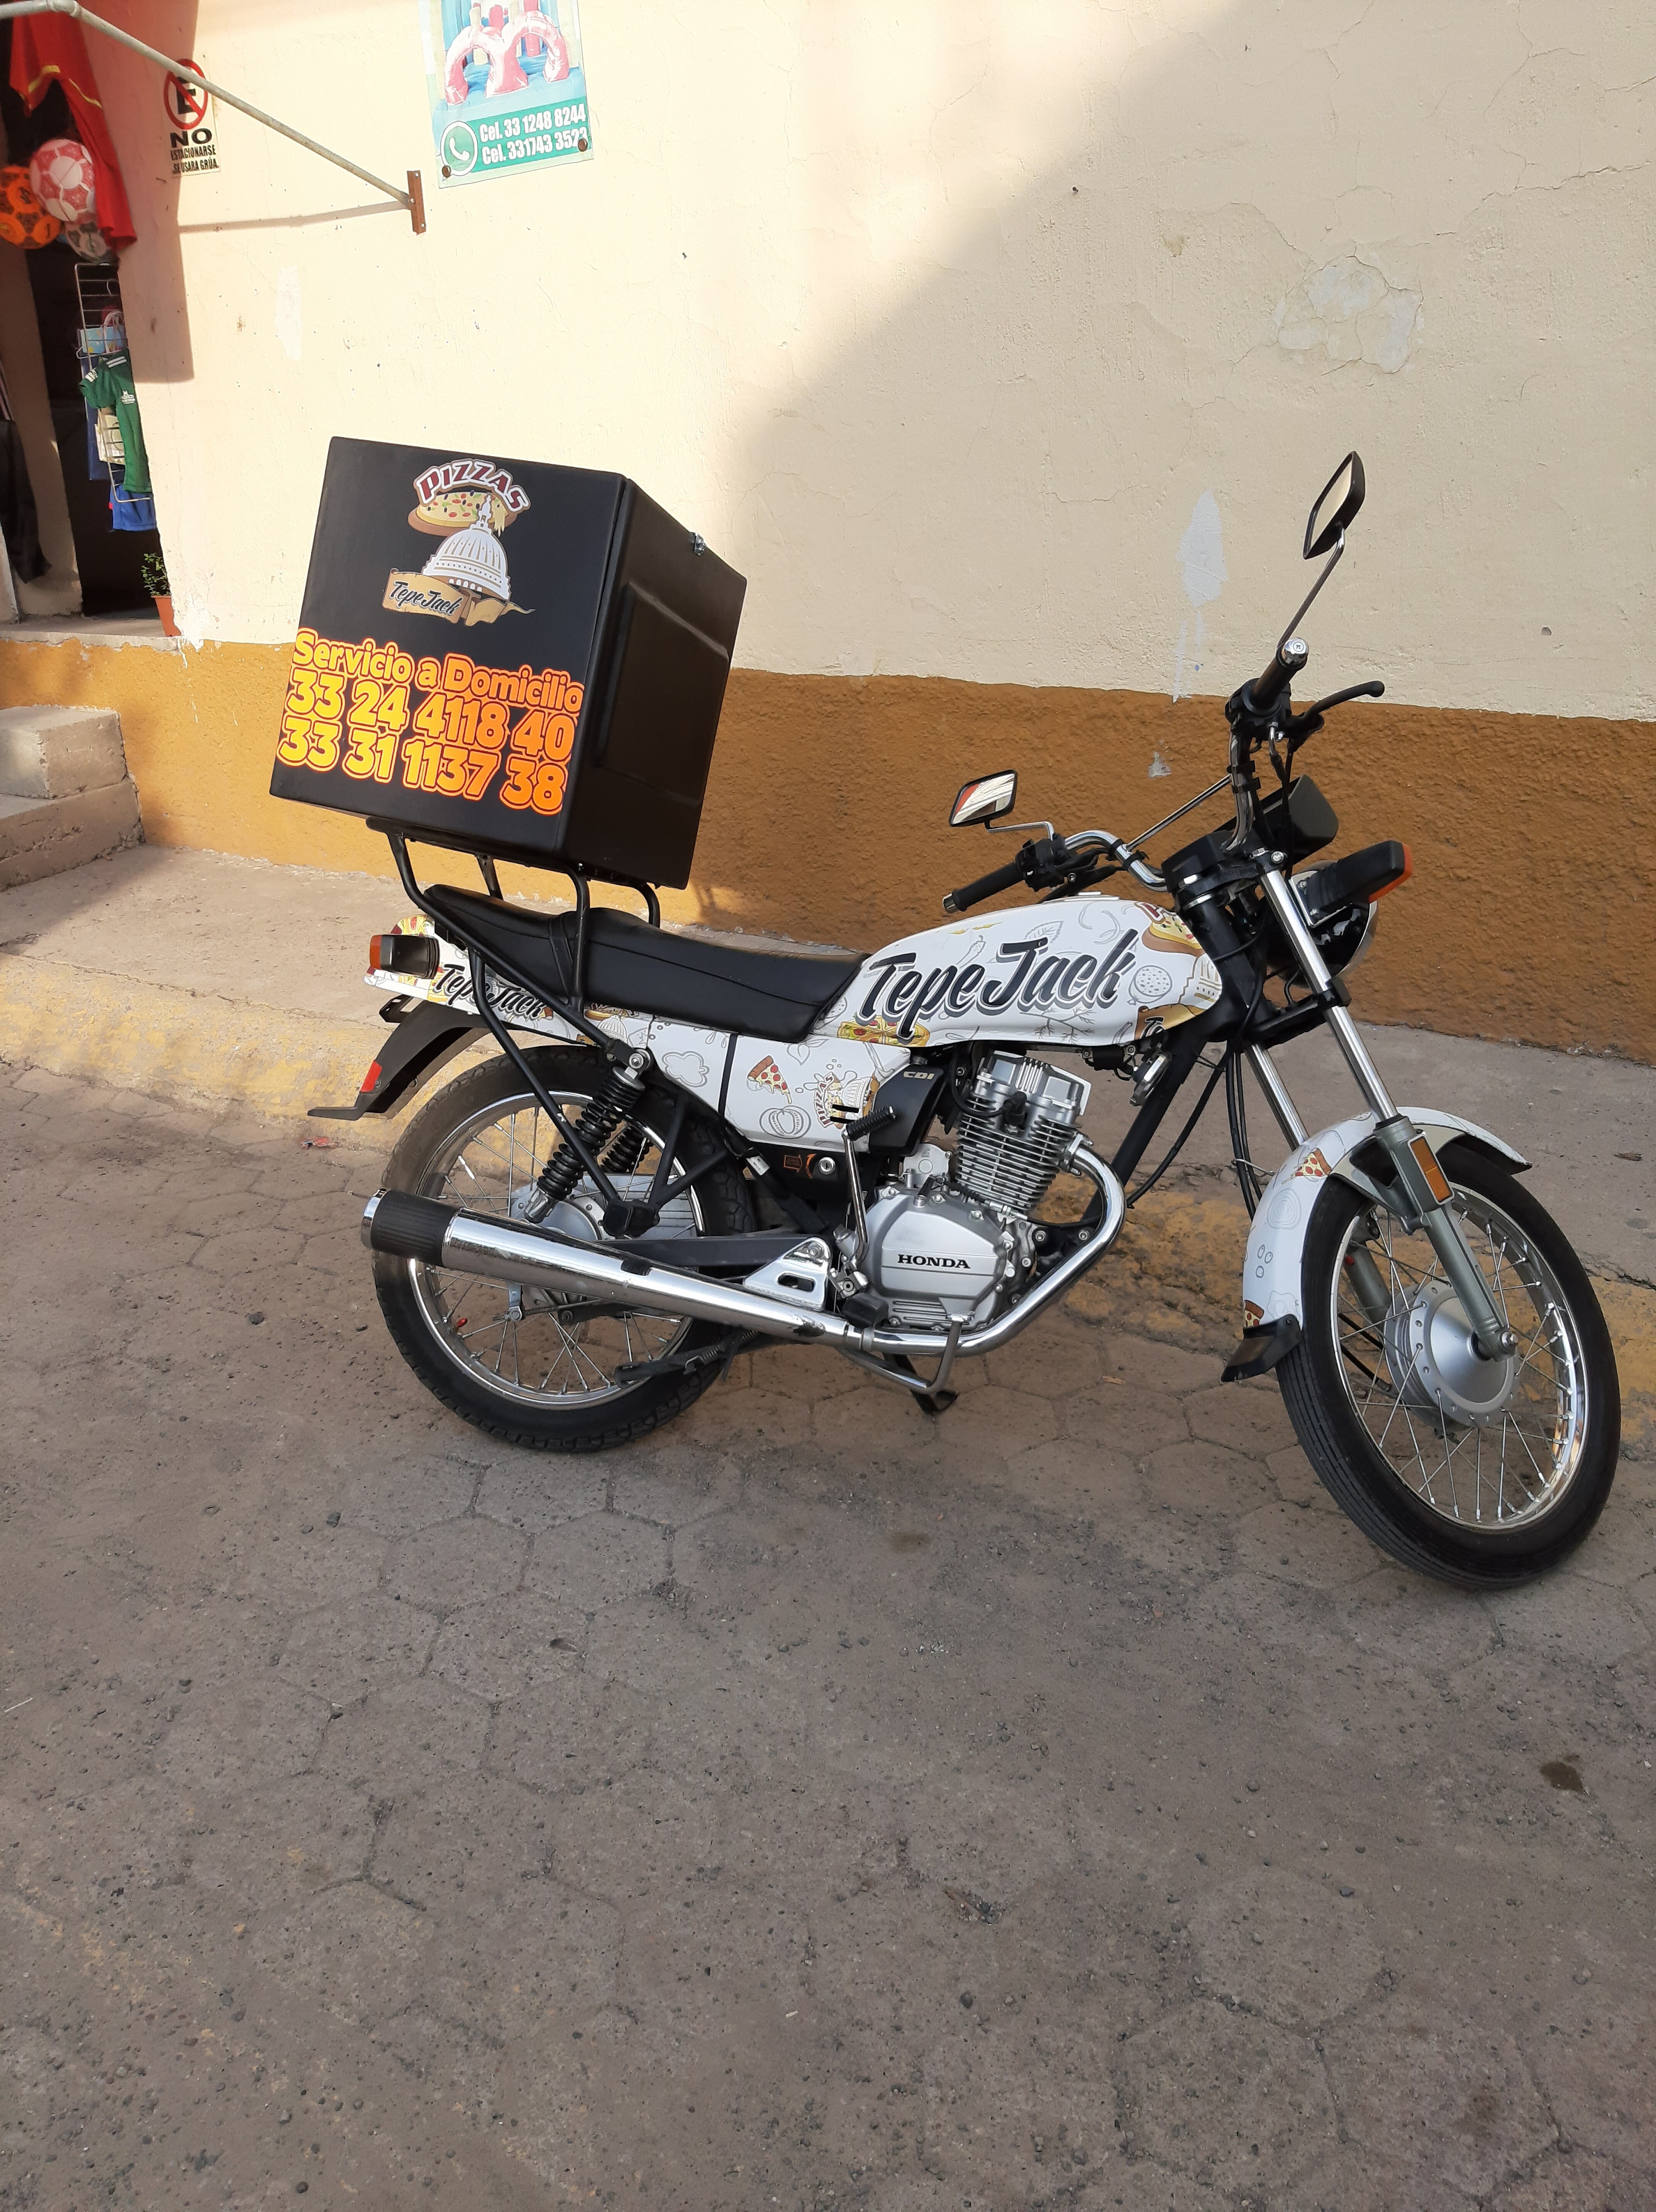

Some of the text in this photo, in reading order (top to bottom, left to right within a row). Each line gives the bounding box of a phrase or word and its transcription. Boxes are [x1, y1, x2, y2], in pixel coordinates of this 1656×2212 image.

[170, 128, 212, 147] NO
[479, 103, 586, 142] Cel. 33 1248 8244
[170, 144, 216, 161] ESTACIONARSE
[482, 127, 588, 165] Cel. 331743 3523
[172, 163, 181, 174] SE
[181, 159, 200, 173] USARA
[416, 460, 530, 512] PIZZAS
[292, 628, 585, 715] Servicio a Domicilio
[285, 667, 576, 763] 33 24 4118 40
[277, 714, 567, 815] 33 31 1137 38
[903, 1071, 935, 1080] CDI
[814, 1072, 835, 1128] PIZZAS
[897, 1254, 971, 1269] HONDA
